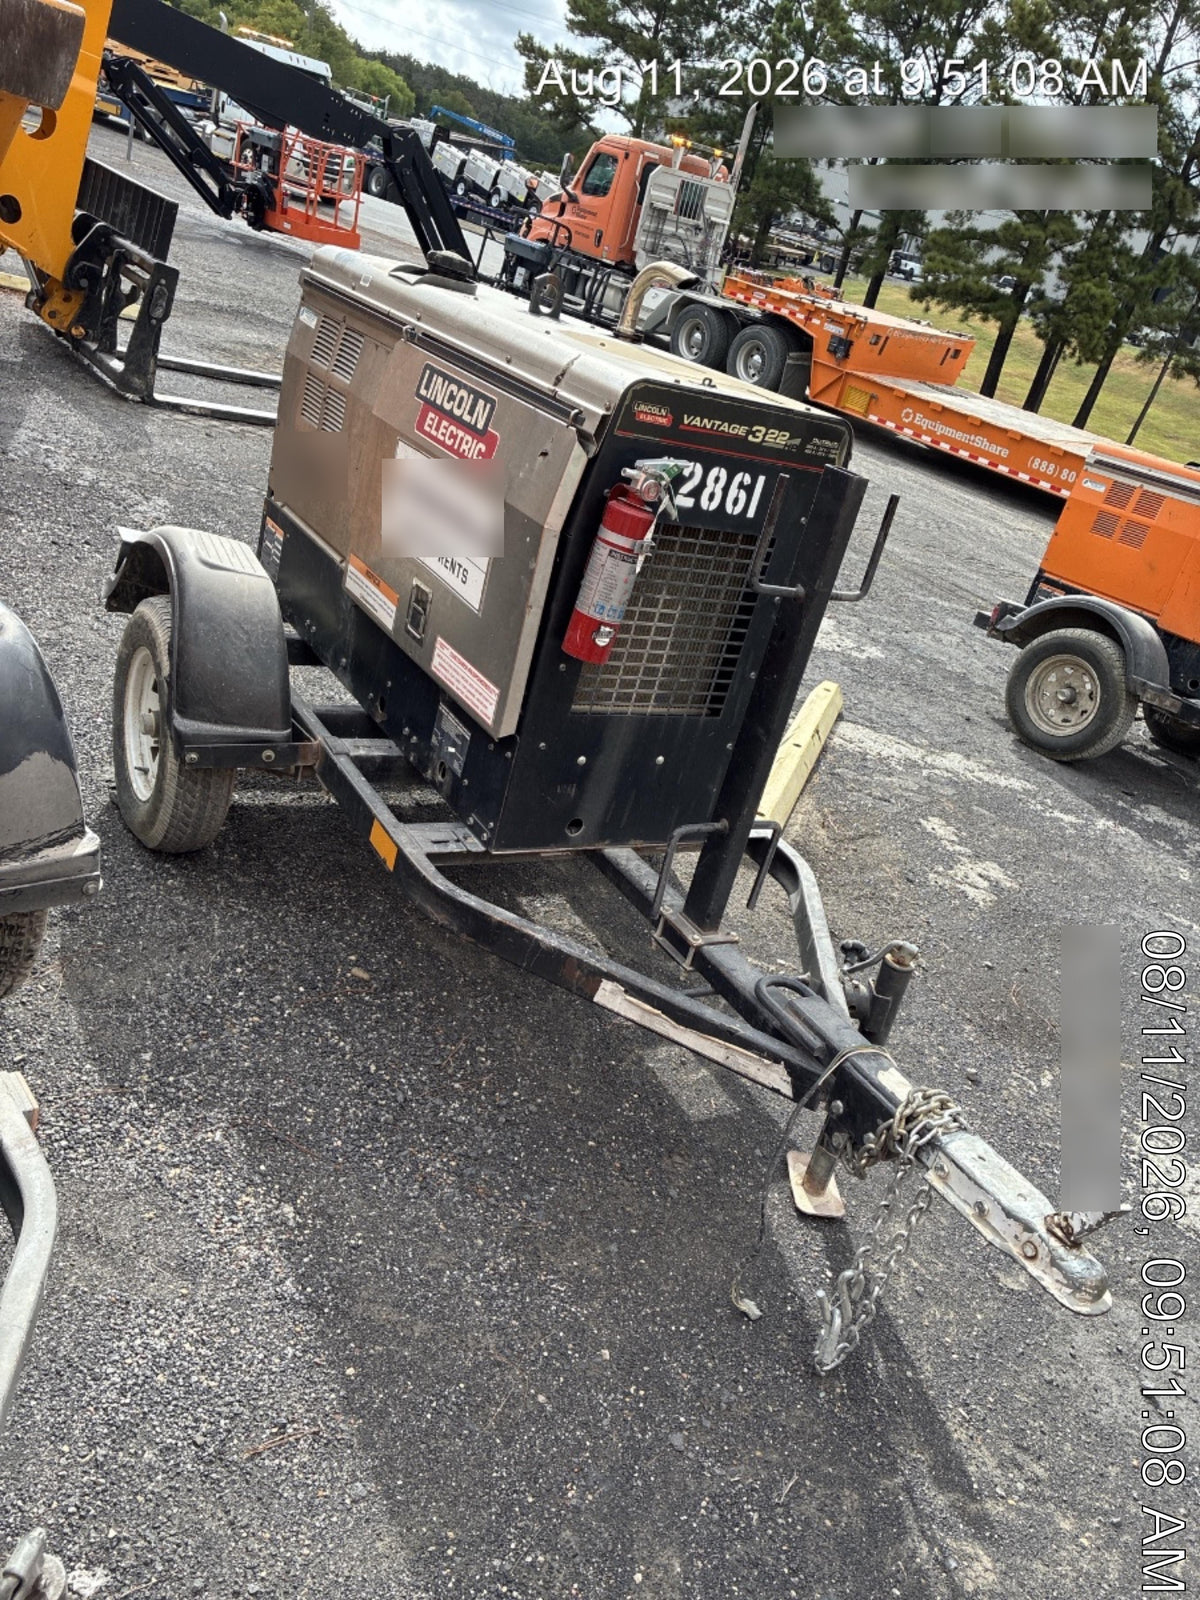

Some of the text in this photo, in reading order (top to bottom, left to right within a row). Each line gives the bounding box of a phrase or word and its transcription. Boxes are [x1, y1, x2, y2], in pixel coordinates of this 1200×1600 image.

[419, 369, 491, 430] LINCOLN
[423, 411, 486, 459] ELECTRIC
[682, 414, 751, 436] VANTAGE
[748, 425, 790, 444] 322
[913, 413, 1009, 458] EquipmentShare
[1027, 456, 1060, 477] (888)
[675, 462, 766, 518] 2861
